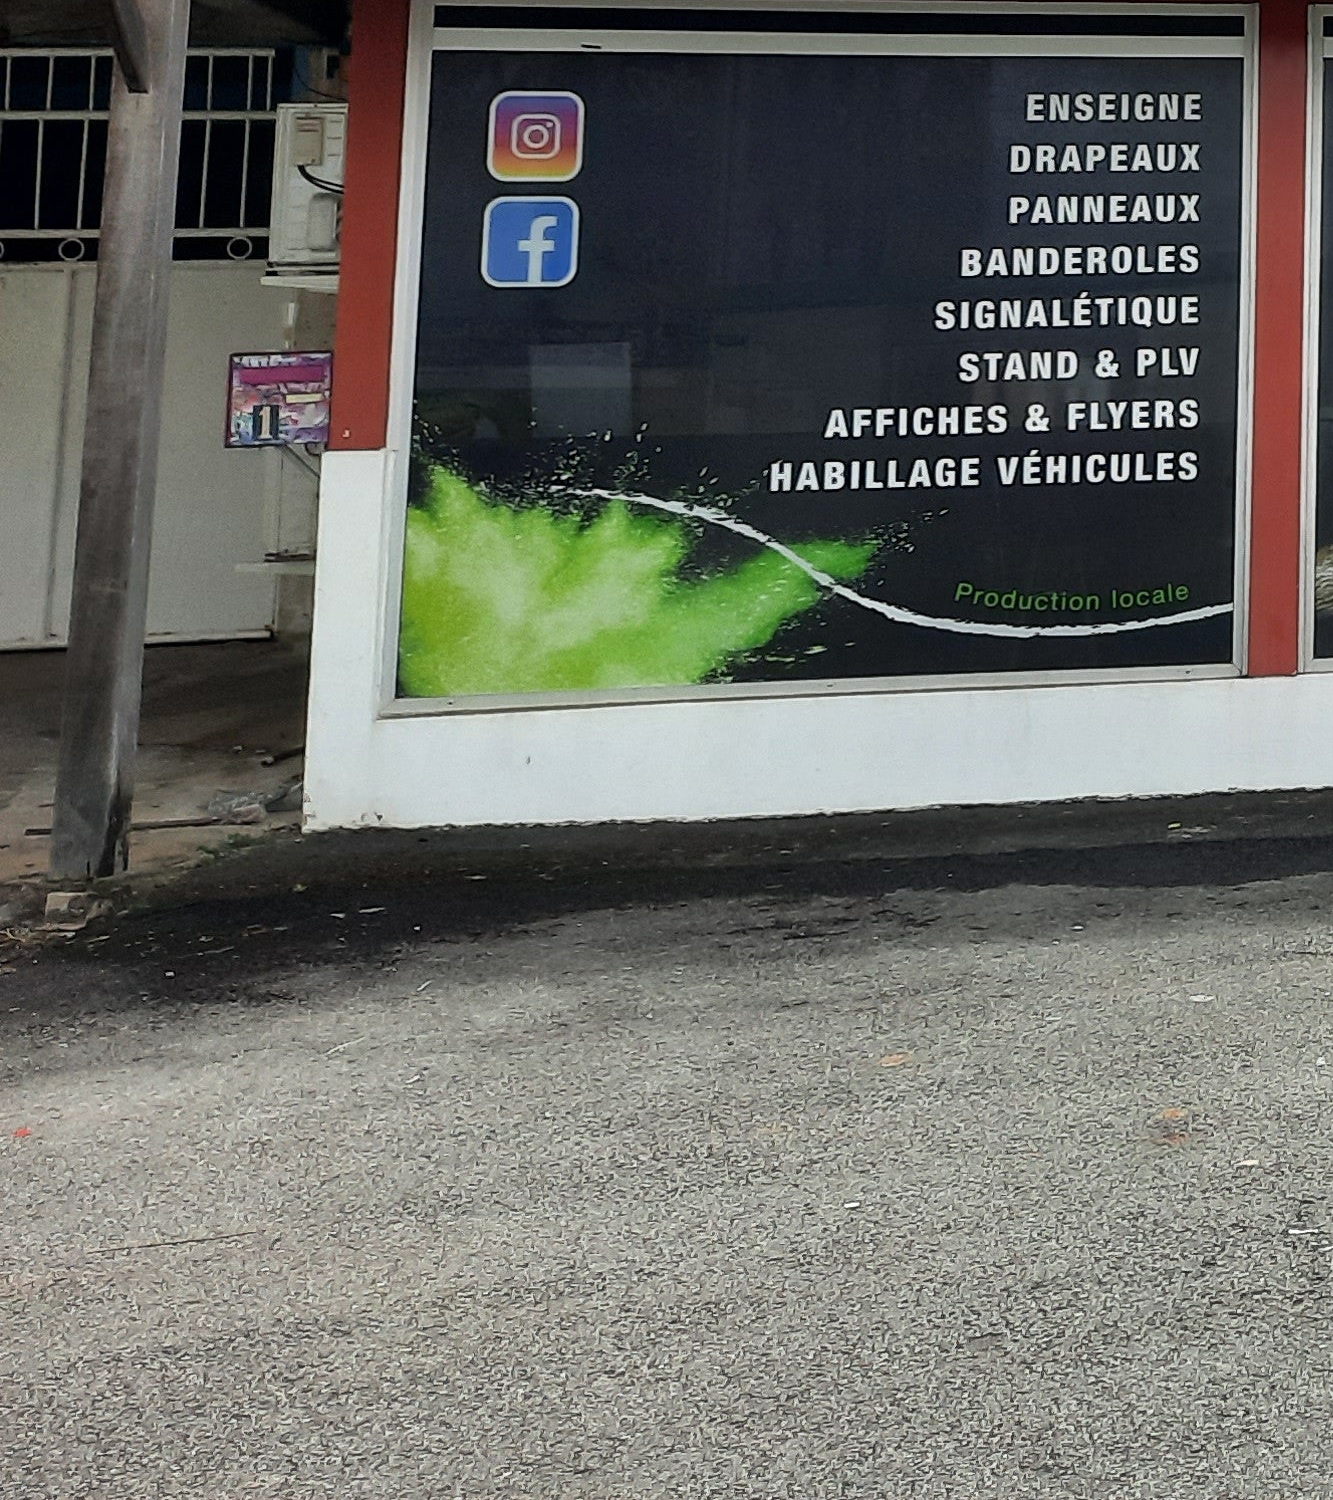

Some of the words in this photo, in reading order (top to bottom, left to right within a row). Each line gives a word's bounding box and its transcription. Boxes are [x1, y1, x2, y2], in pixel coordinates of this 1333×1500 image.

[1026, 92, 1202, 121] ENSEIGNE
[1010, 143, 1200, 173] DRAPEAUX
[1008, 194, 1200, 224] PANNEAUX
[961, 245, 1200, 276] BANDEROLES
[934, 292, 1200, 330] SIGNALÉTIQUE
[958, 350, 1078, 382] STAND
[1094, 349, 1120, 378] &
[1137, 347, 1199, 376] PLV
[824, 405, 1008, 438] AFFICHES
[1024, 404, 1050, 432] &
[1067, 399, 1199, 431] FLYERS
[770, 457, 980, 491] HABILLAGE
[997, 450, 1198, 485] VÉHICULES
[954, 582, 1100, 611] Production
[1111, 583, 1190, 608] locale
